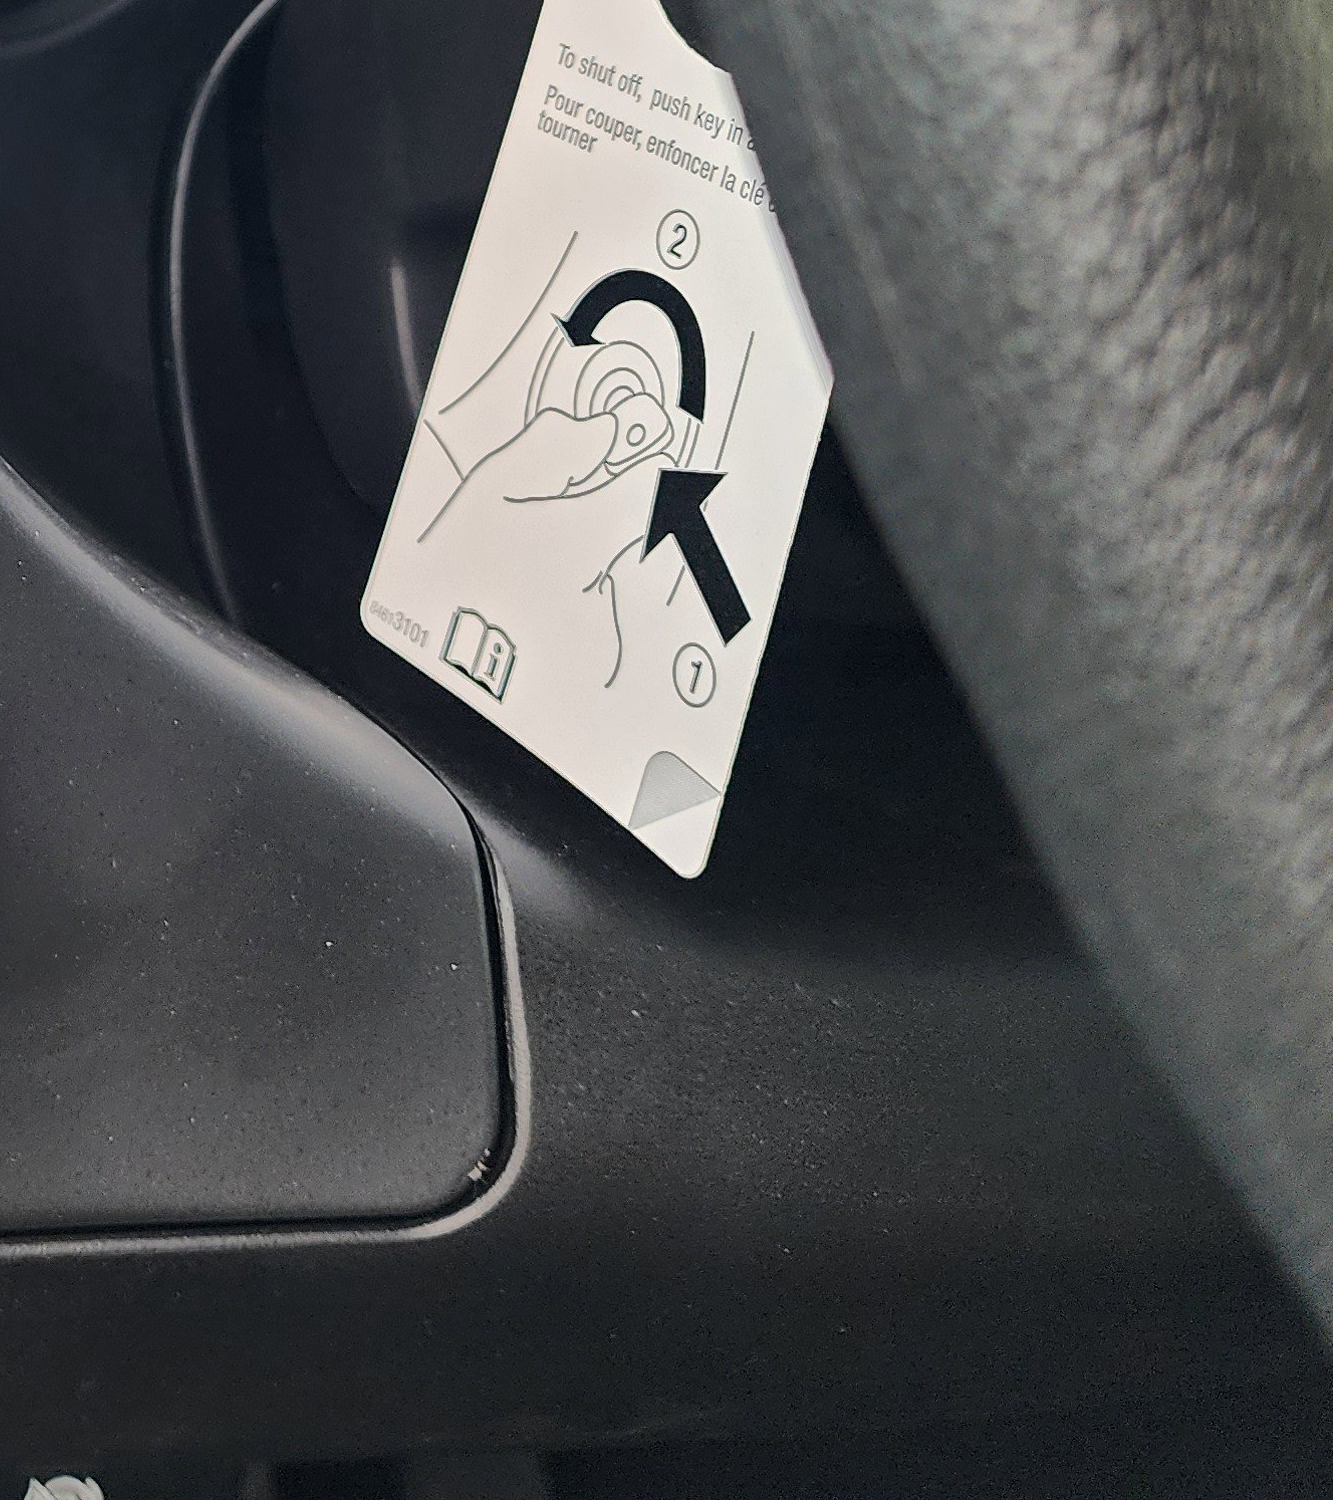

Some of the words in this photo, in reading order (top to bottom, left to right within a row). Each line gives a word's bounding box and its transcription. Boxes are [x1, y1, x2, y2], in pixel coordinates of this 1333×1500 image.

[556, 43, 574, 69] To
[578, 55, 616, 88] shut
[617, 73, 643, 104] off,
[649, 88, 691, 121] push
[693, 103, 725, 140] key
[727, 117, 744, 146] in
[536, 108, 599, 154] tourner
[543, 84, 585, 119] Pour
[585, 106, 643, 152] couper,
[645, 134, 720, 183] enfoncer
[719, 164, 737, 193] la
[666, 223, 688, 259] 2
[689, 660, 703, 694] 1
